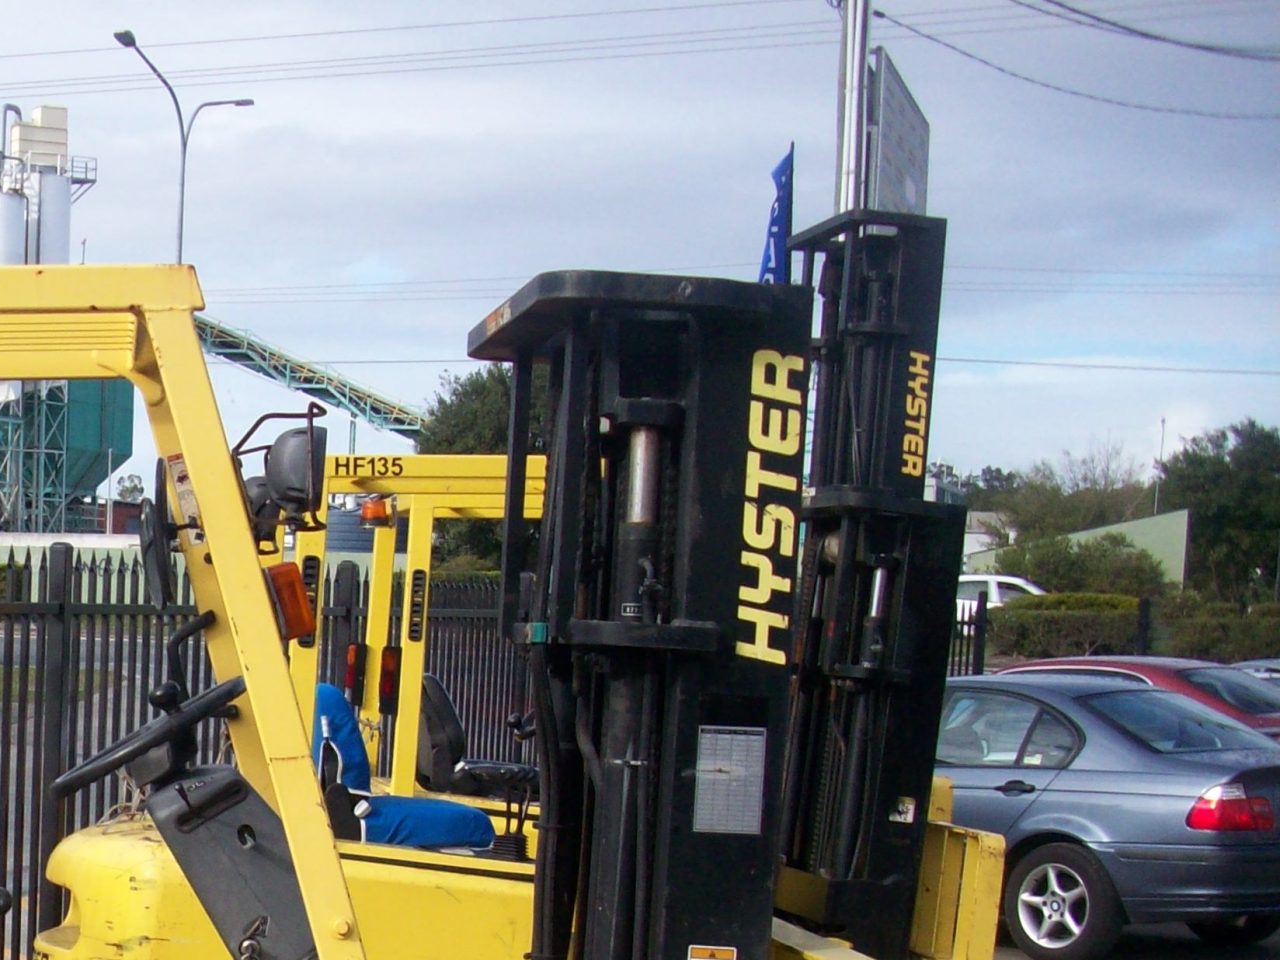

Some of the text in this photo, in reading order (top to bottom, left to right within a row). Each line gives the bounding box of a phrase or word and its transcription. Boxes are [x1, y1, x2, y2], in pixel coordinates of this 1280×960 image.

[334, 456, 404, 476] HF135
[901, 350, 930, 477] HYSTER
[735, 349, 804, 665] HYSTER
